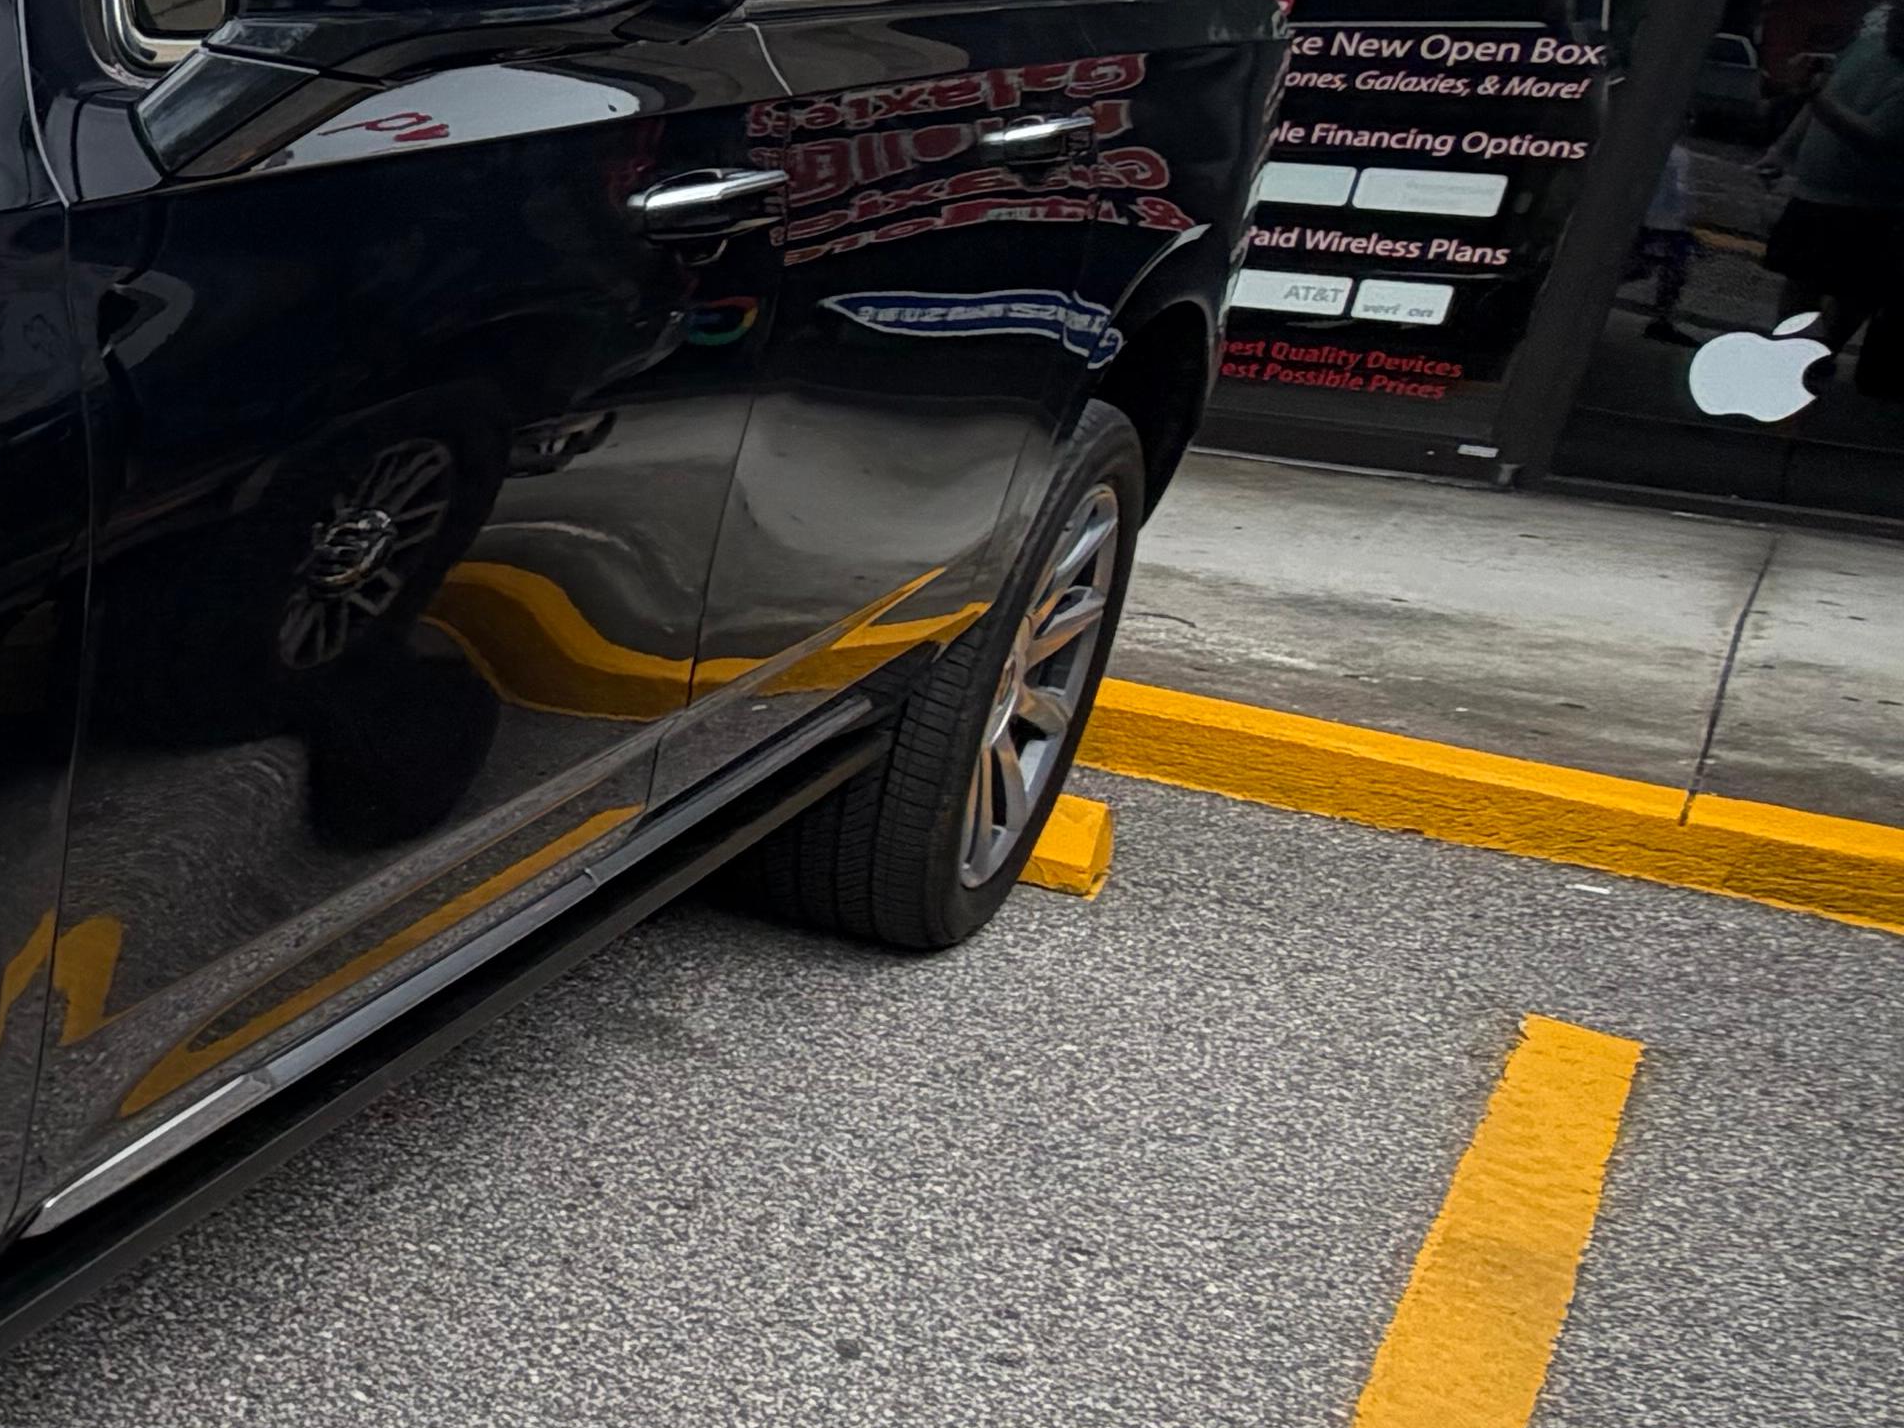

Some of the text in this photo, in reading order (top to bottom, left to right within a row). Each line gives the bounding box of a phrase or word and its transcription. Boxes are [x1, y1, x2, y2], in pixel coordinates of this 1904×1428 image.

[1331, 32, 1414, 59] New
[1420, 34, 1521, 66] Open
[1531, 37, 1604, 66] Box
[1284, 70, 1591, 100] ones, Galaxies, & More!
[1271, 121, 1588, 160] le Financing Options
[1305, 229, 1421, 258] Wireless
[1427, 238, 1512, 265] Plans
[1283, 285, 1344, 304] AT&T
[1271, 341, 1363, 369] Quality
[1366, 351, 1463, 378] Devices
[1221, 363, 1446, 400] est Possible Prices
